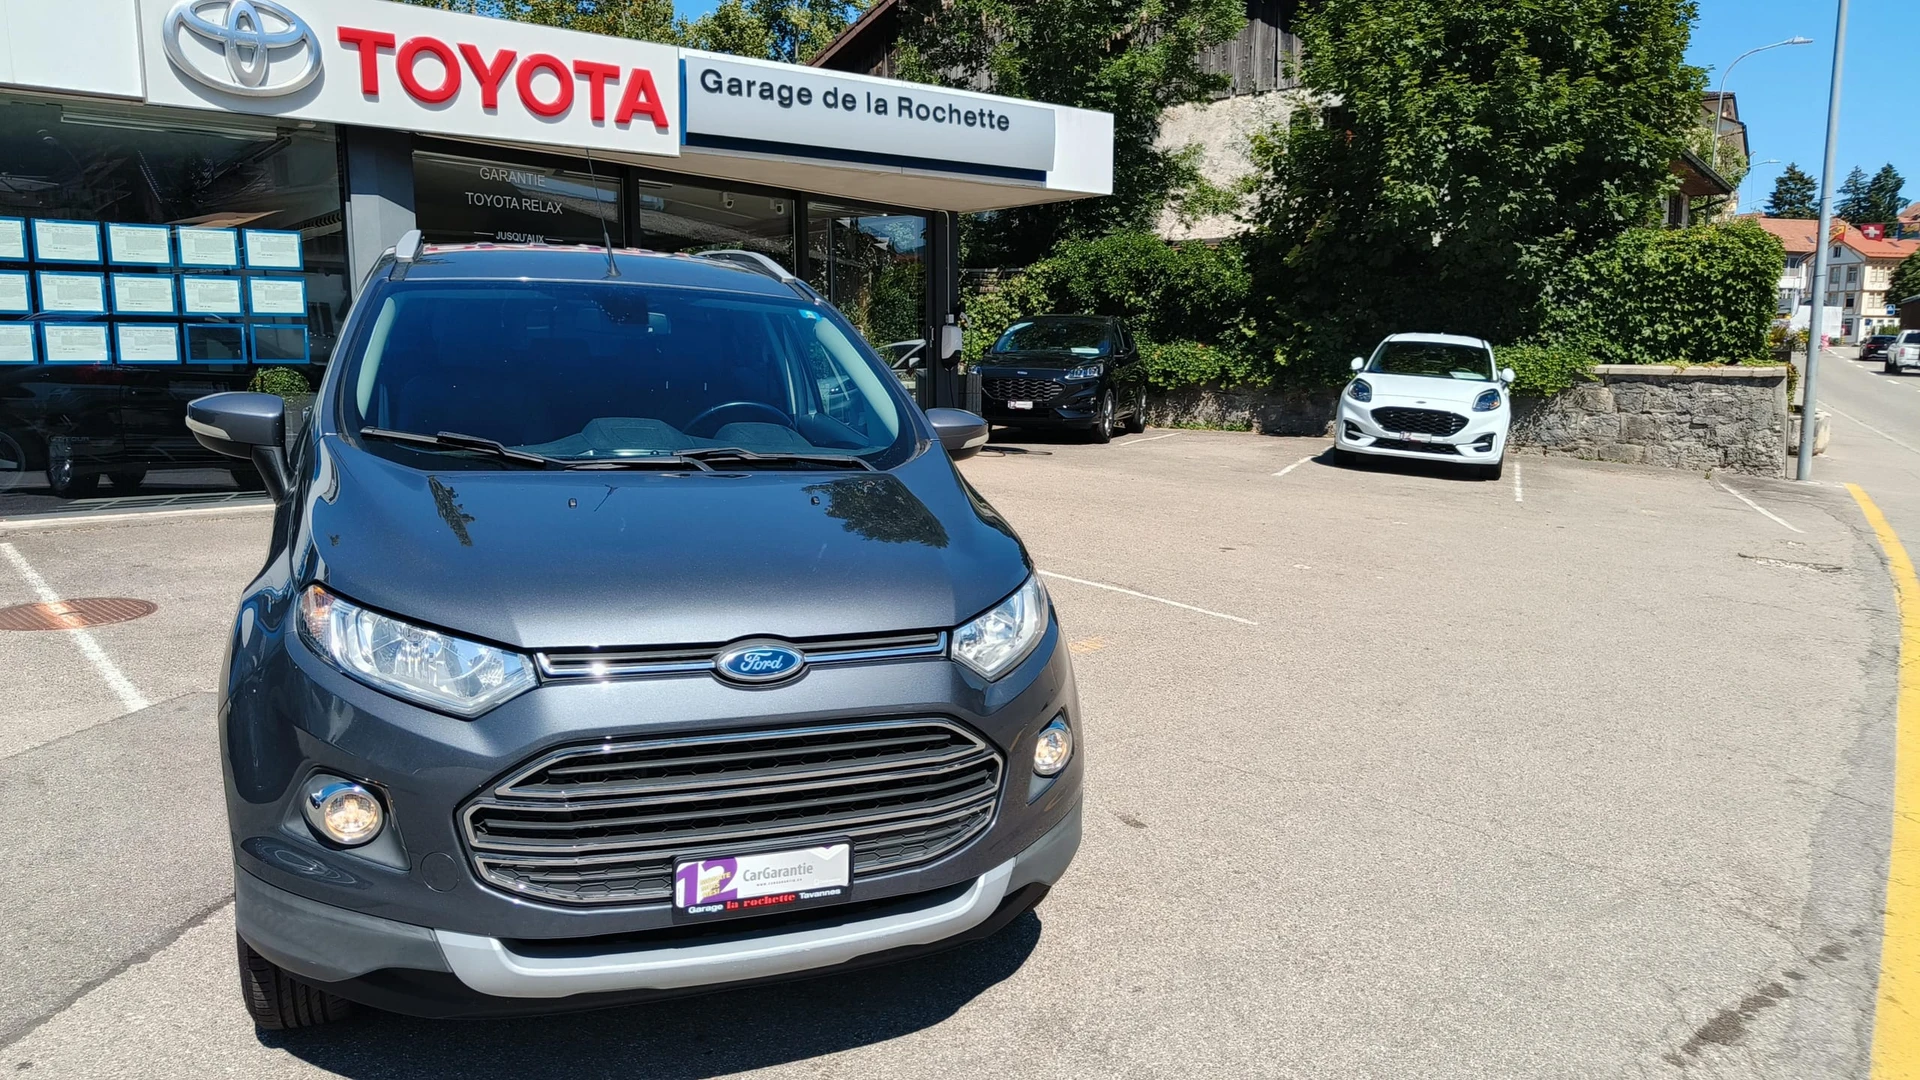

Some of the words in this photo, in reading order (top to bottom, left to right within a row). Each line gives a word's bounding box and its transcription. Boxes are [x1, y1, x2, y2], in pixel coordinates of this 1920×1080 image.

[337, 26, 669, 128] TOYOTA
[700, 68, 812, 109] Garage
[822, 86, 857, 111] de
[866, 92, 888, 115] la
[898, 96, 1010, 132] Rochette
[479, 167, 546, 187] GARANTIE
[465, 192, 519, 210] TOYOTA
[522, 198, 563, 214] RELAX
[495, 231, 544, 243] JUSQU'AUX
[740, 652, 783, 671] Ford
[676, 857, 738, 907] 12
[743, 863, 813, 882] CarGarantie
[688, 904, 723, 914] Garage
[727, 900, 739, 909] la
[743, 893, 796, 907] rochette
[799, 888, 841, 900] Tavannes
